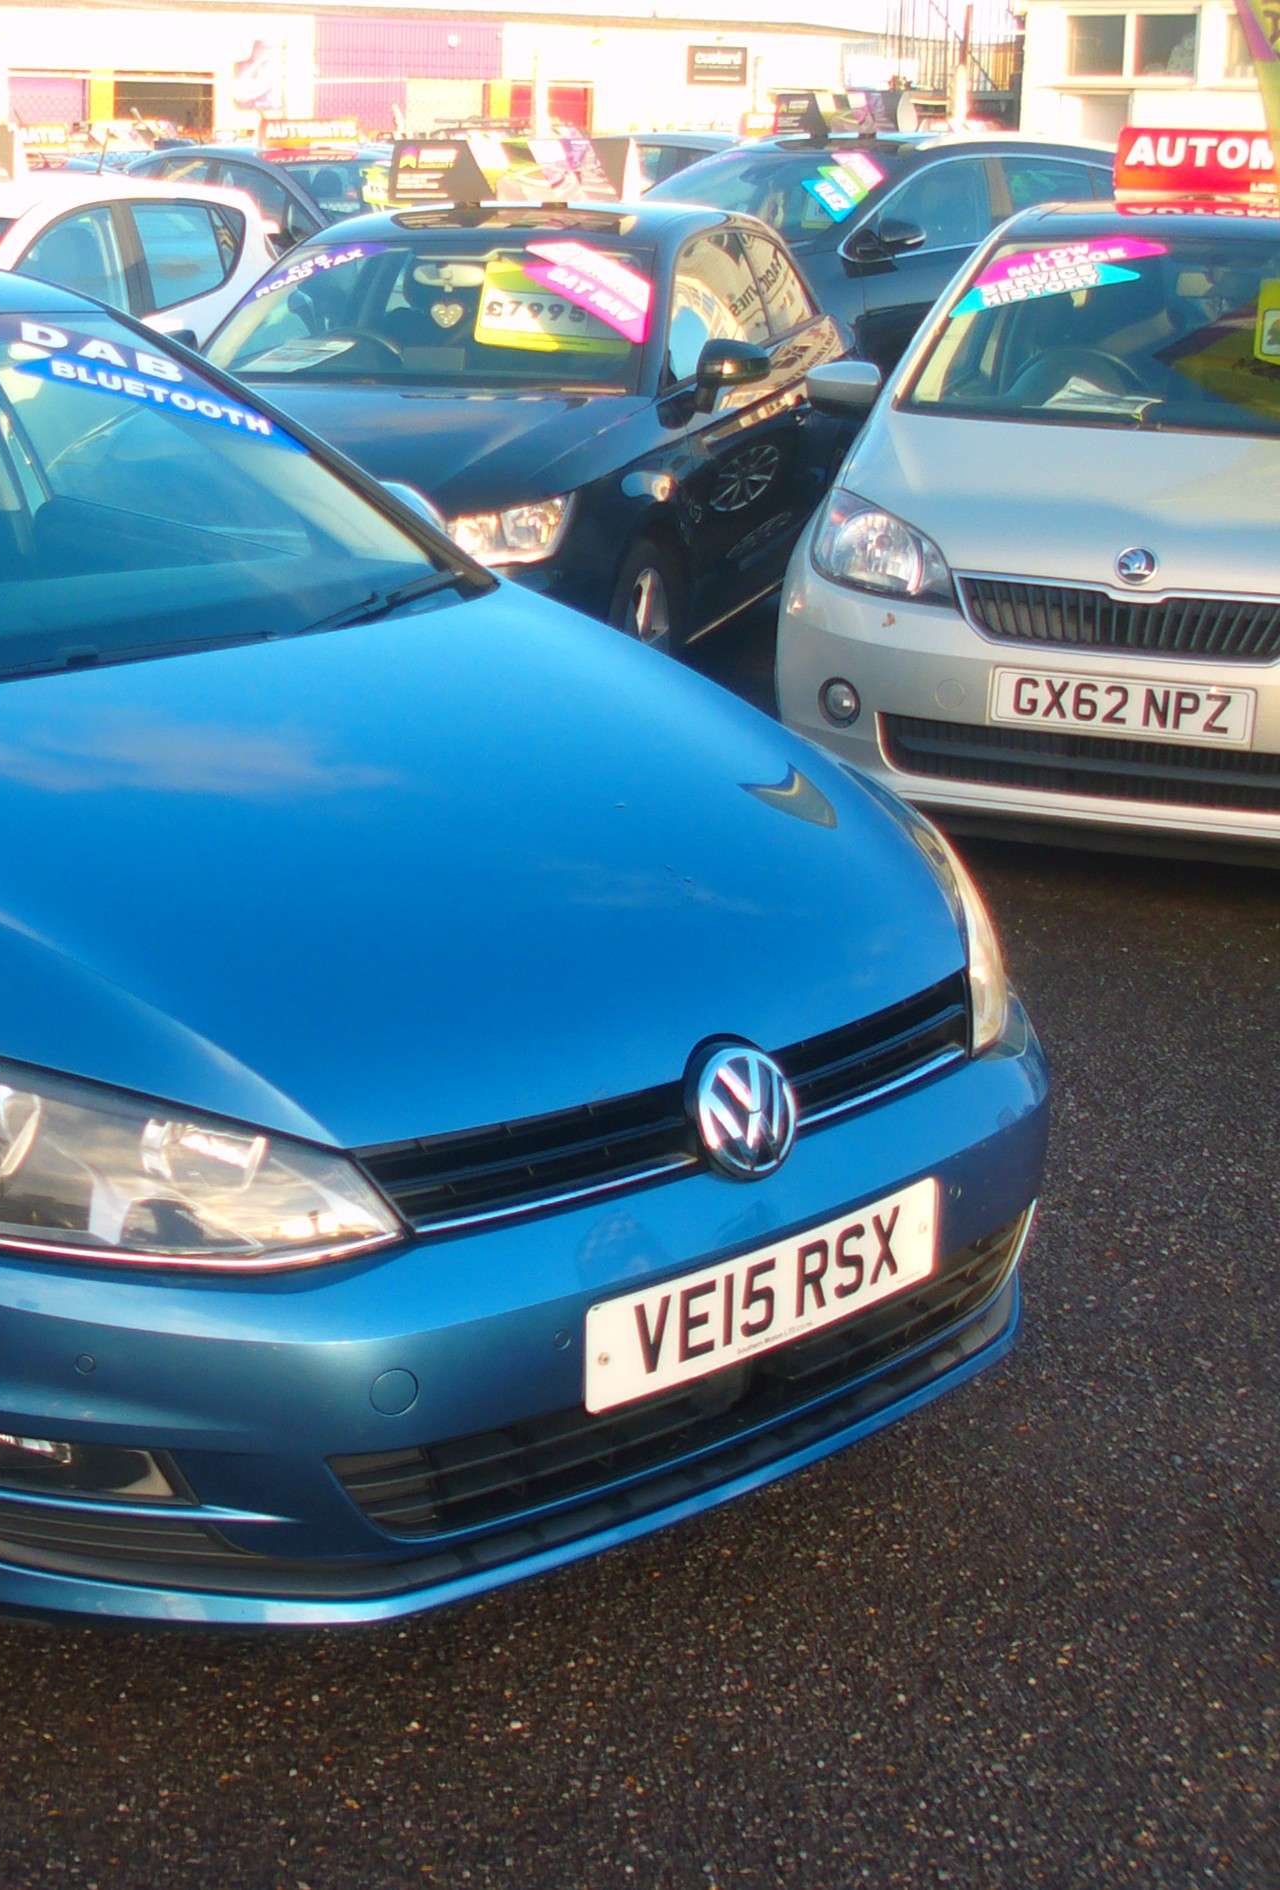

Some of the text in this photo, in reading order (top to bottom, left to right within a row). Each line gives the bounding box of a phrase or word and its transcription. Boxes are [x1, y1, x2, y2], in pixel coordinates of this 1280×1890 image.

[1007, 248, 1127, 278] MILEAGE
[1033, 244, 1089, 262] LOW
[255, 249, 364, 299] ROAD TAX
[980, 264, 1095, 294] SERVICE
[983, 274, 1099, 307] HISTORY
[486, 300, 587, 323] £7995
[21, 321, 184, 382] DAB
[51, 359, 272, 436] BLUETOOTH
[1012, 677, 1233, 734] GX62 NPZ
[634, 1205, 901, 1374] VE15 RSX
